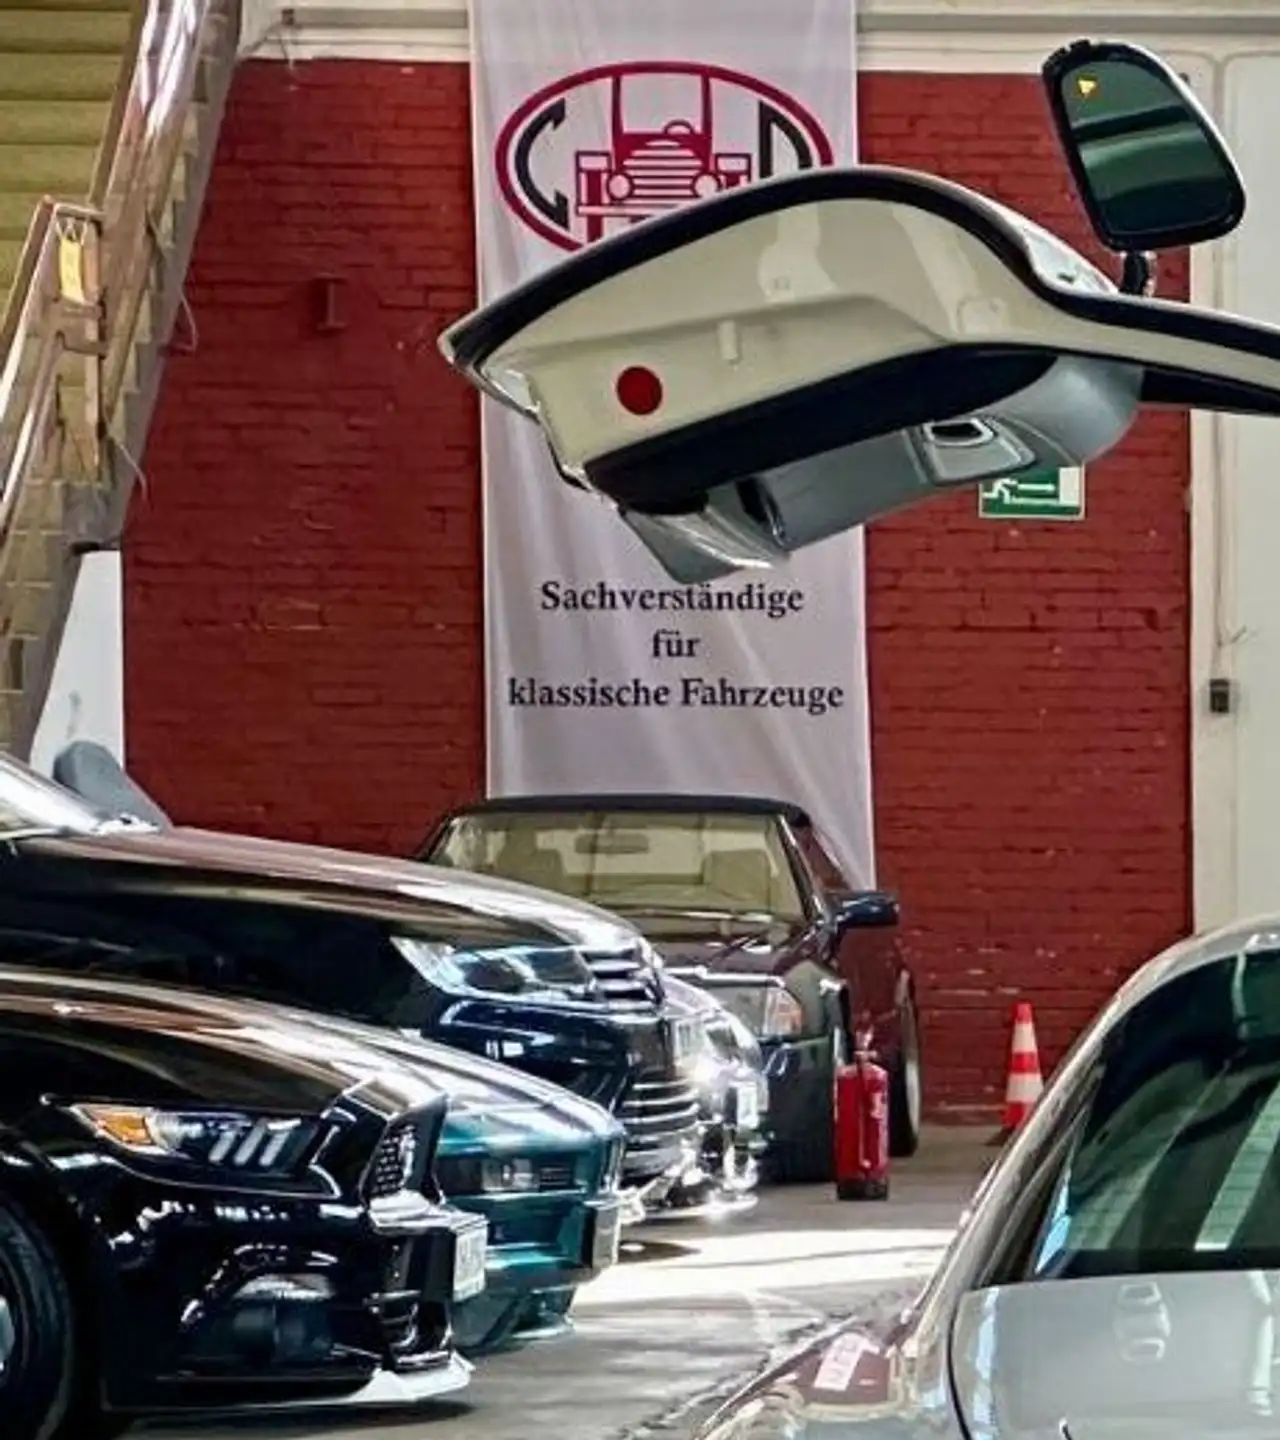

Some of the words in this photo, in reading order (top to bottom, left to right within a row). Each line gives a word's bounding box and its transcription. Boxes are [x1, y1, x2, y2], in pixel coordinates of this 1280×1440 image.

[540, 580, 804, 617] Sachverständige
[651, 628, 700, 659] für
[508, 676, 669, 708] klassische
[680, 677, 844, 715] Fahrzeuge
